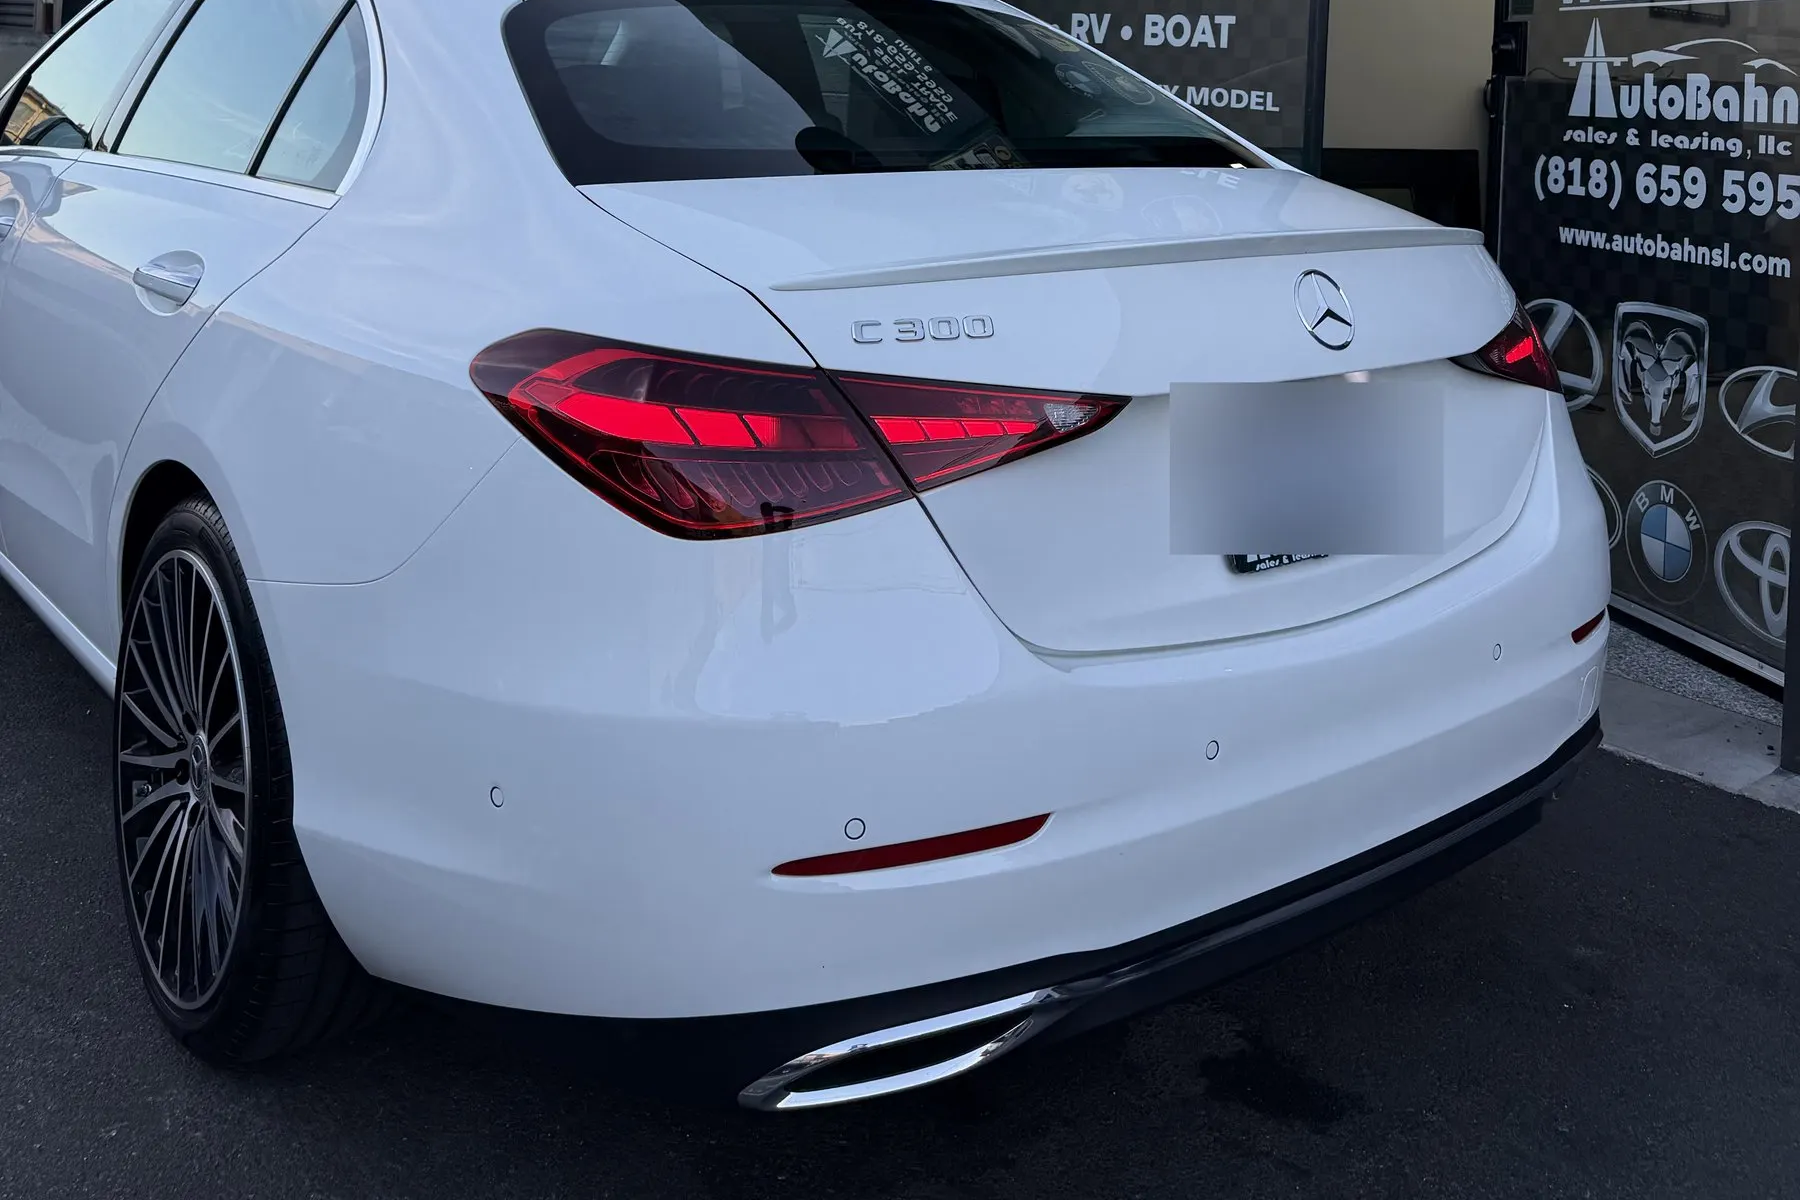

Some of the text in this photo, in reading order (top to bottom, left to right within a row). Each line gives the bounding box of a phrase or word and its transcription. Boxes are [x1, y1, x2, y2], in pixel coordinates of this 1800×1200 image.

[1071, 13, 1236, 48] RV BOAT
[1186, 86, 1280, 112] MODEL
[1563, 126, 1618, 145] sales
[1625, 128, 1640, 146] &
[1758, 134, 1793, 156] llc
[1534, 154, 1800, 220] (818) 659 595
[1558, 226, 1791, 278] www.autobahnsl.com
[851, 314, 995, 344] C 300
[1635, 485, 1700, 532] BMW
[1255, 558, 1280, 571] sales
